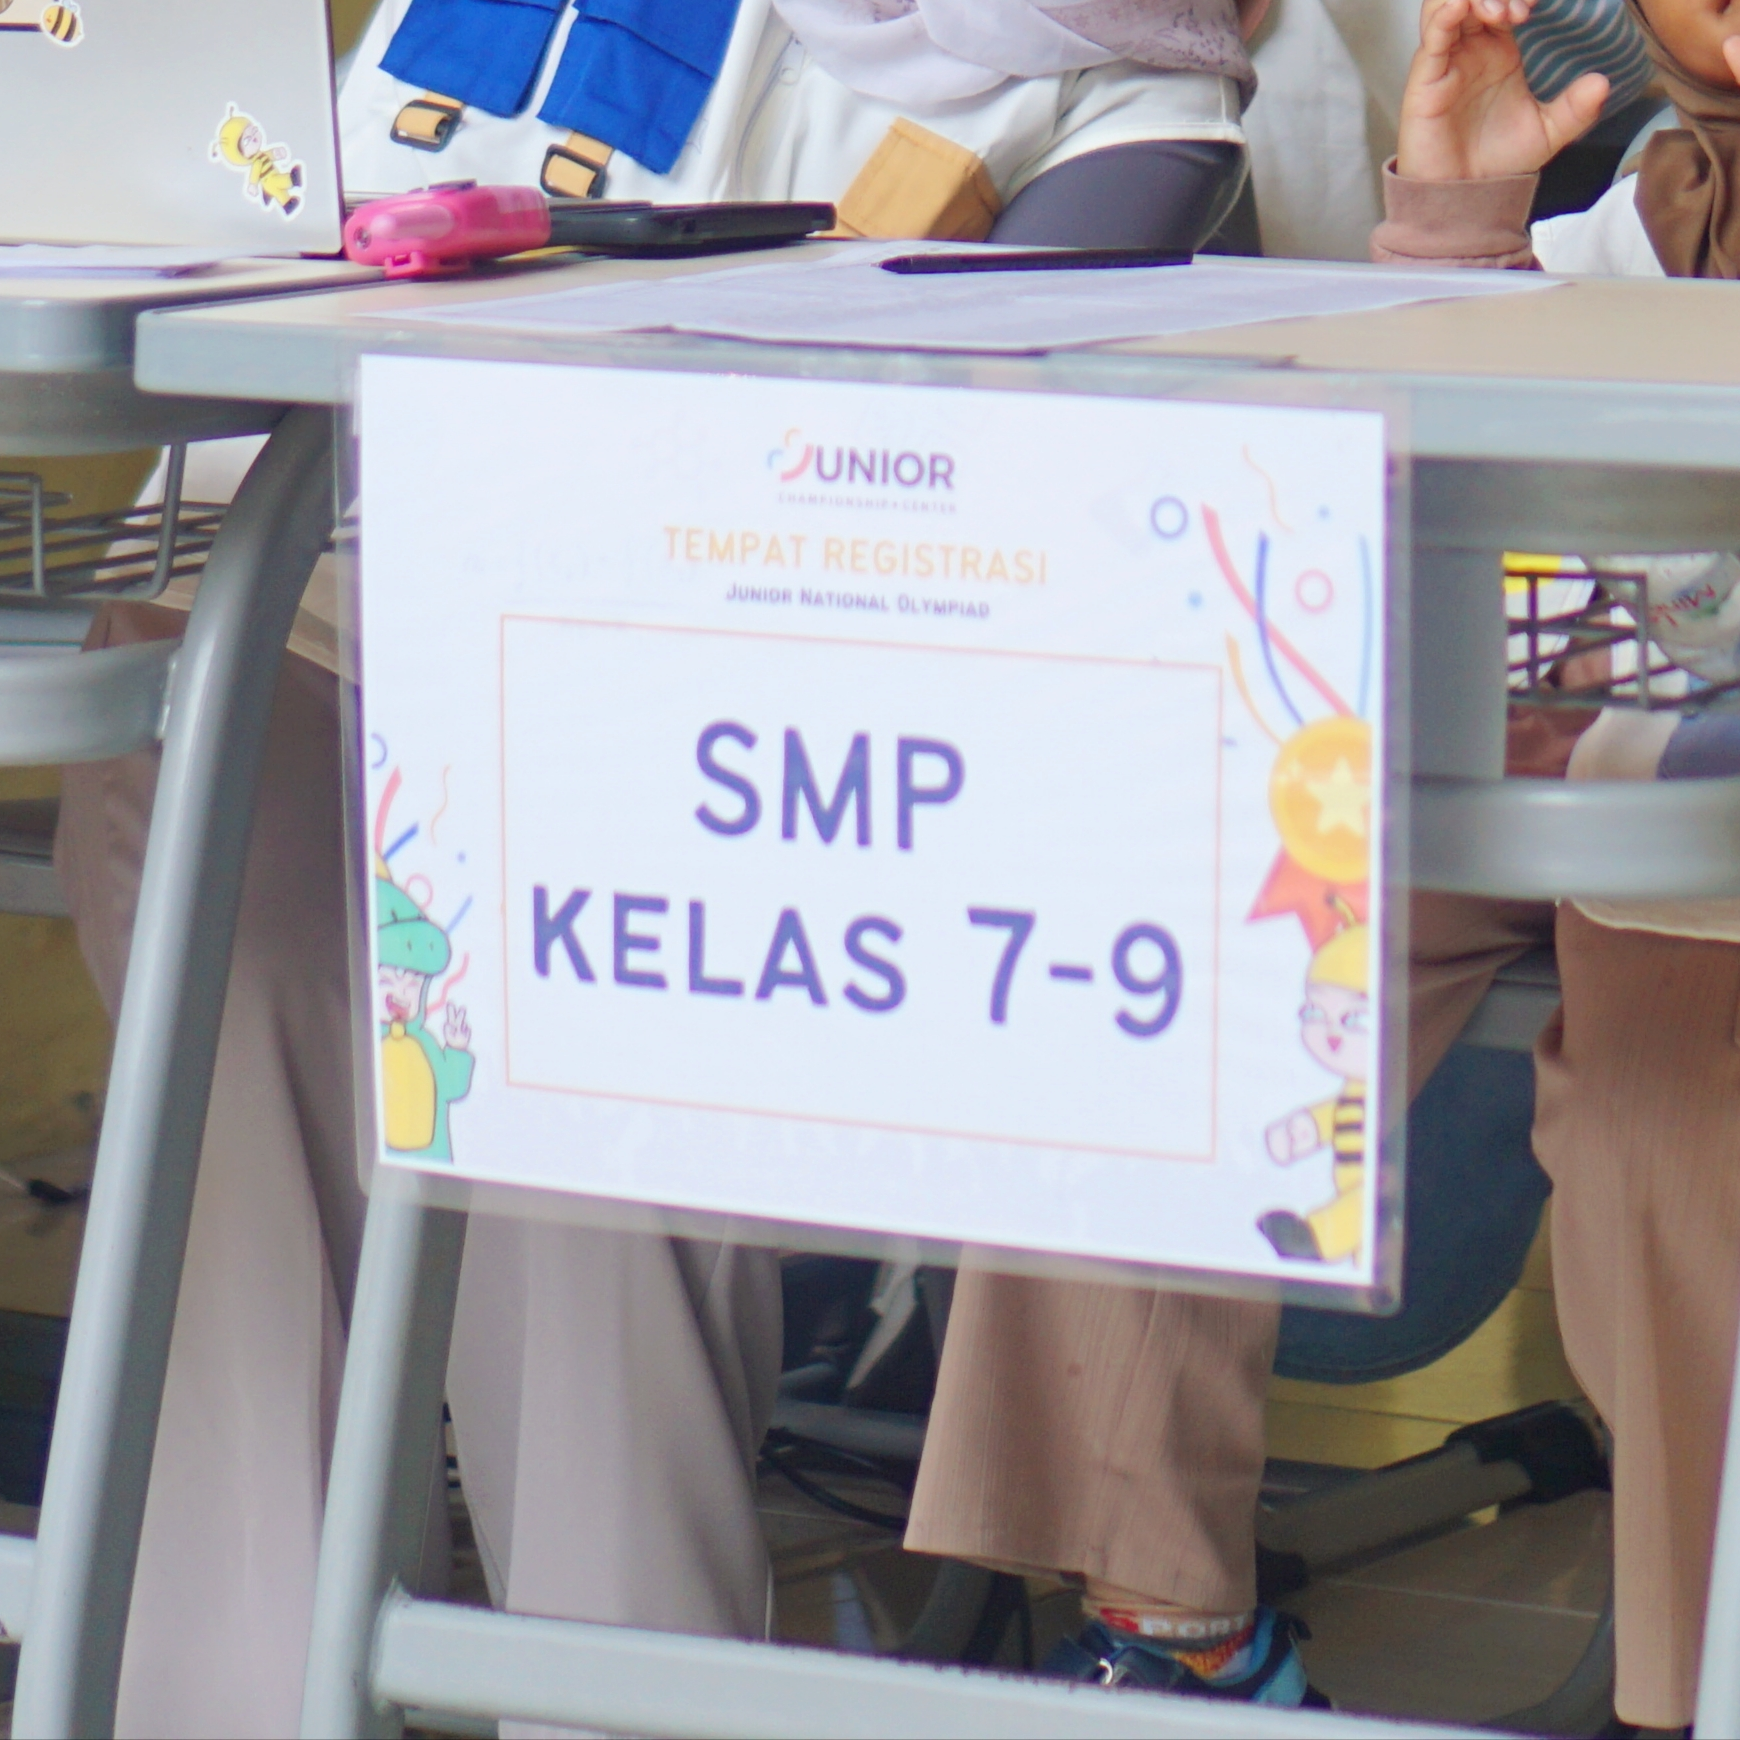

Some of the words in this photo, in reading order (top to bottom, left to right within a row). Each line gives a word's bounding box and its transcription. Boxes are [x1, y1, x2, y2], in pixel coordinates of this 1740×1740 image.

[771, 436, 956, 492] JUNIOR
[663, 525, 808, 570] TEMPAT
[822, 536, 1049, 587] REGISTRASI
[694, 719, 966, 852] SMP
[531, 884, 909, 1014] KELAS
[966, 906, 1185, 1040] 7-9
